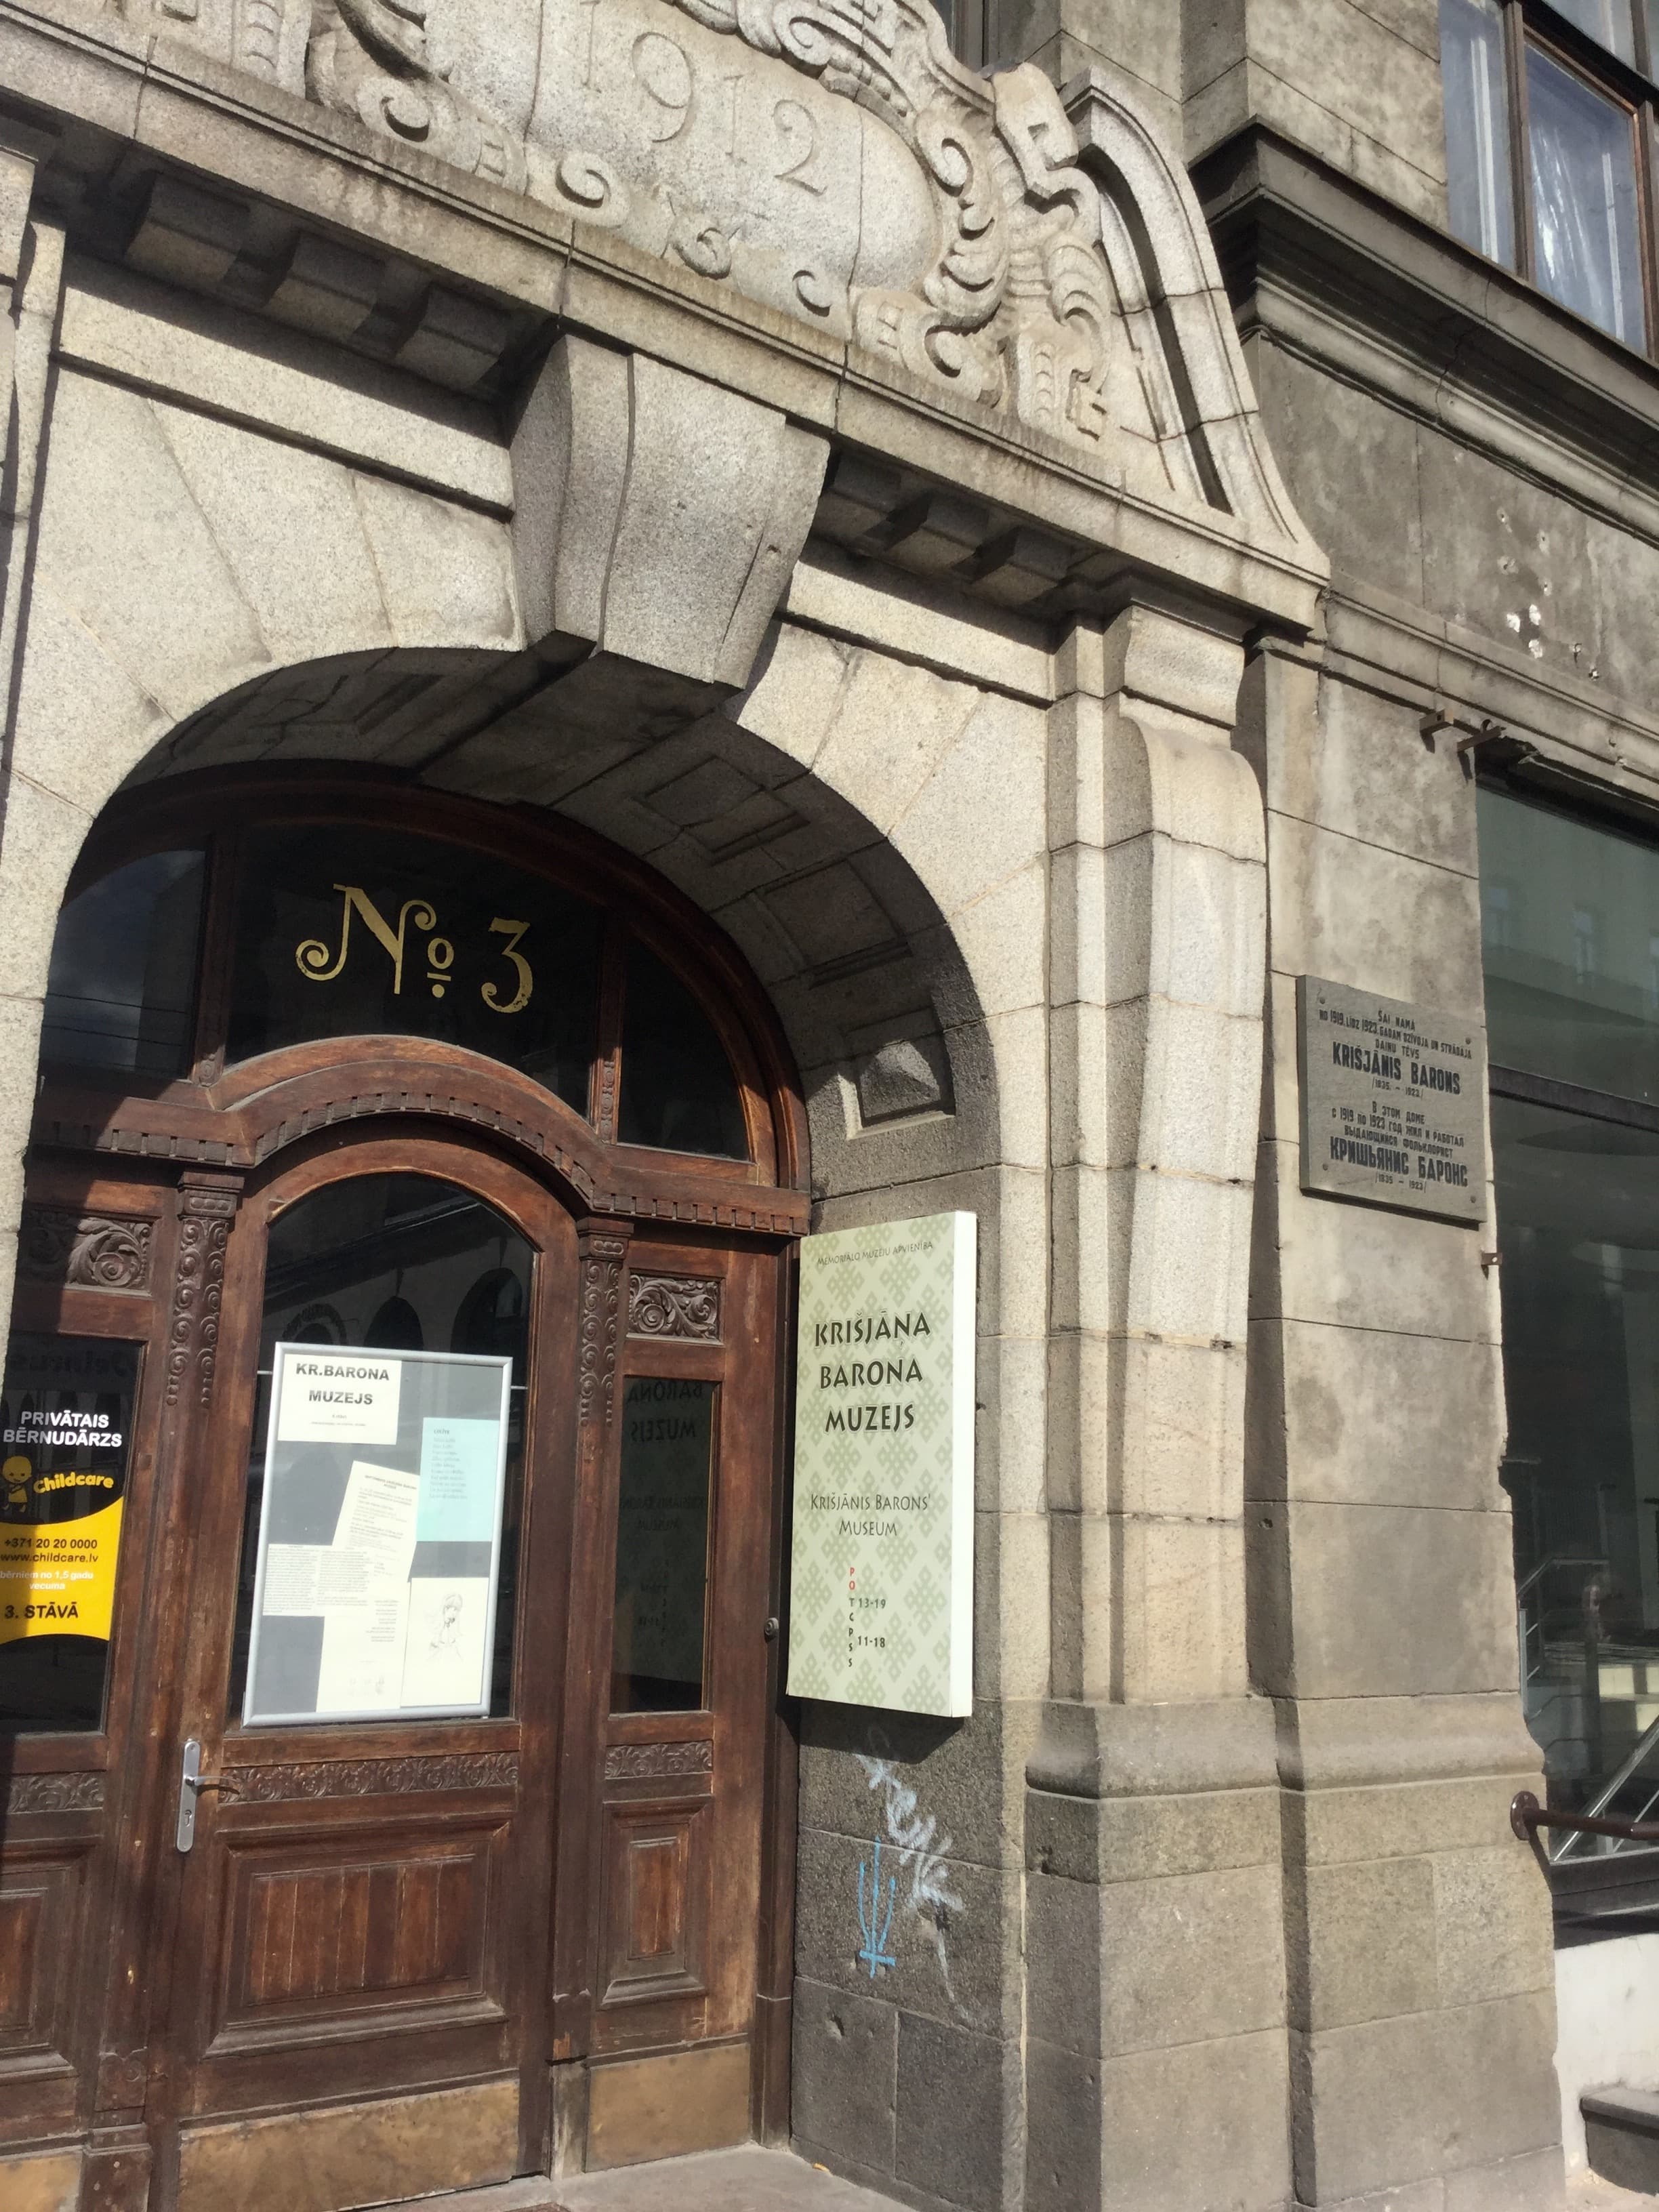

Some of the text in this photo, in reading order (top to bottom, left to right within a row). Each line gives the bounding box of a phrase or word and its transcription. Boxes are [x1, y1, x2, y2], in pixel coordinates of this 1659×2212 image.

[578, 0, 828, 197] 1912
[481, 917, 533, 1013] 3
[1380, 1026, 1401, 1042] GADAM
[1403, 1032, 1429, 1048] DZĪVOJA
[1431, 1040, 1438, 1050] UN
[1441, 1042, 1472, 1060] STRĀDĀJA
[1332, 1042, 1460, 1095] KRIŠJĀNIS BARONS
[1372, 1101, 1425, 1125] В ЭТОМ ДОМЕ
[1332, 1107, 1465, 1148] С 1919 ПО 1923 ГОД ЖИЛ И РАБОТАЛ
[1345, 1124, 1453, 1159] ВЫДАЮЩИЙСЯ ФОЛЬКЛОРИСТ
[1330, 1136, 1468, 1187] КРИШЬЯНИС БАРОНС
[862, 1248, 890, 1260] MUZEJU
[815, 1311, 930, 1347] KRIŠJĀŅA
[295, 1363, 390, 1380] KR.BARONA
[821, 1358, 923, 1389] BARONA
[309, 1390, 373, 1405] MUZEJS
[21, 1410, 109, 1428] PRIVĀTAIS
[825, 1404, 914, 1433] MUZEJS
[3, 1427, 122, 1447] BĒRNUDĀRZS
[5, 1538, 98, 1549] +371 20 20 0000
[0, 1553, 98, 1563] www.childcare.lv
[0, 1571, 38, 1579] bērniem
[70, 1571, 94, 1580] gadu
[850, 1567, 855, 1576] P
[5, 1601, 79, 1619] 3. STĀVĀ
[859, 1598, 886, 1609] 13-19
[858, 1636, 885, 1647] 11-18
